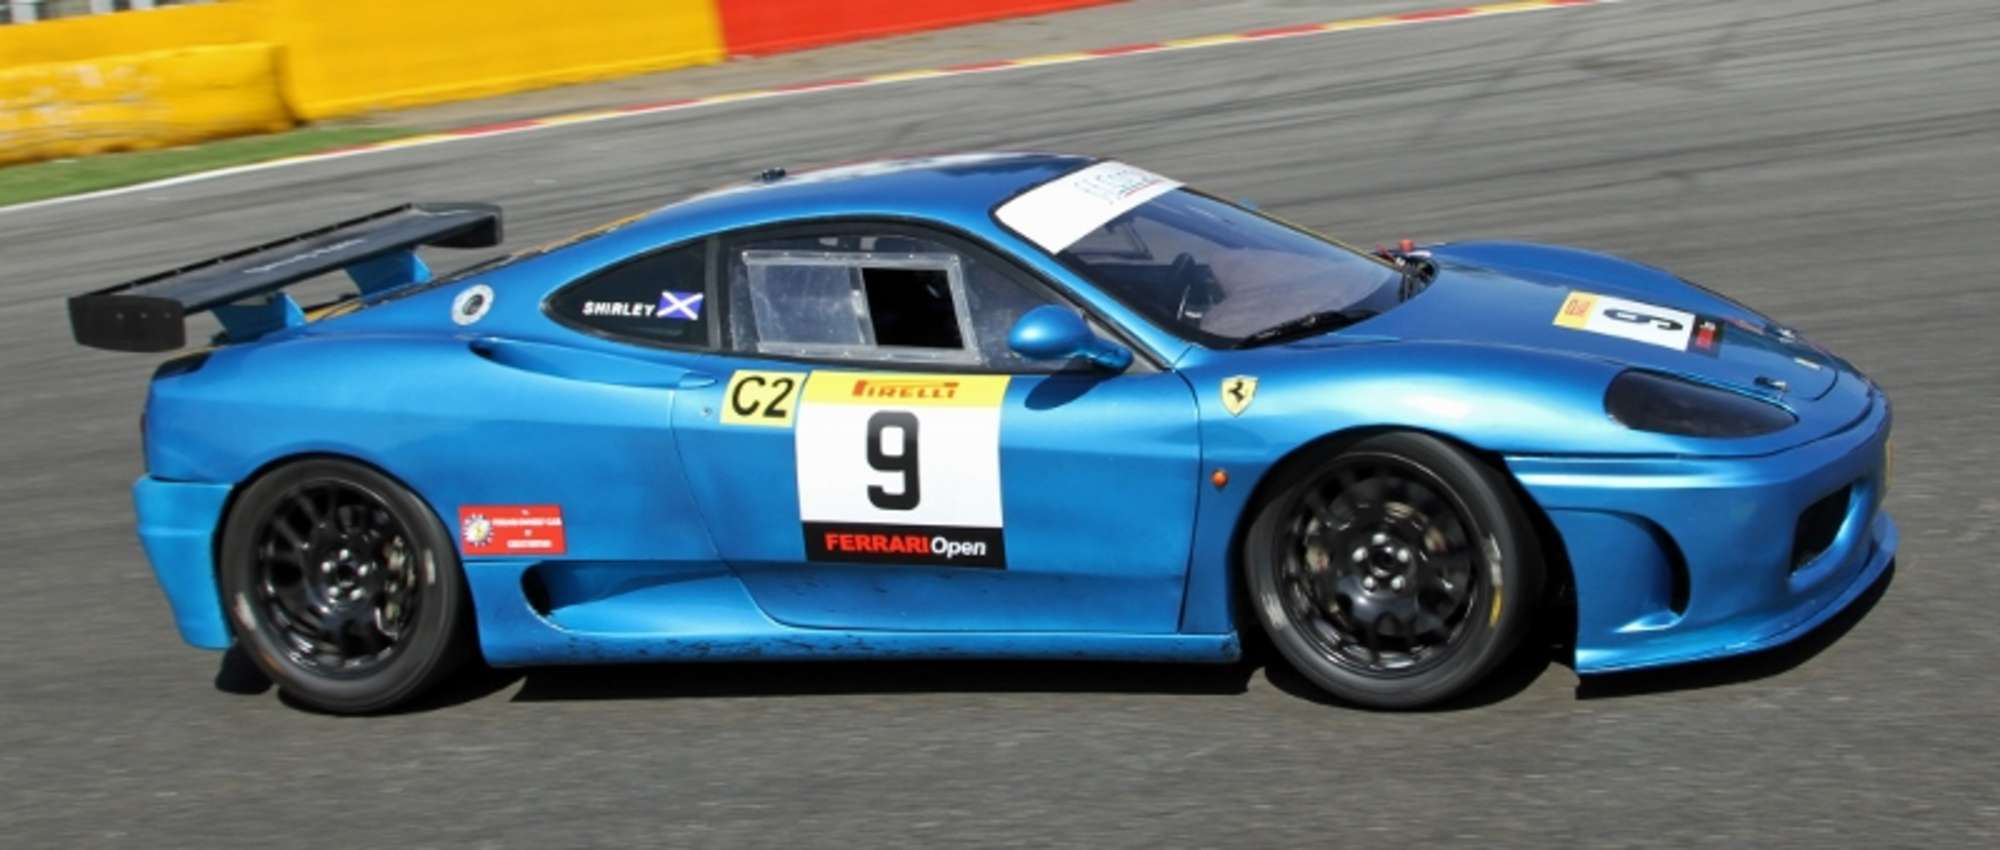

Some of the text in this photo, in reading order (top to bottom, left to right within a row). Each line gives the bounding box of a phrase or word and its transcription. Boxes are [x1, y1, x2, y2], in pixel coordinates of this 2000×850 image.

[582, 301, 656, 316] SHIRLEY
[731, 376, 794, 418] C2
[852, 379, 959, 399] PIRELLI
[866, 410, 921, 511] 9
